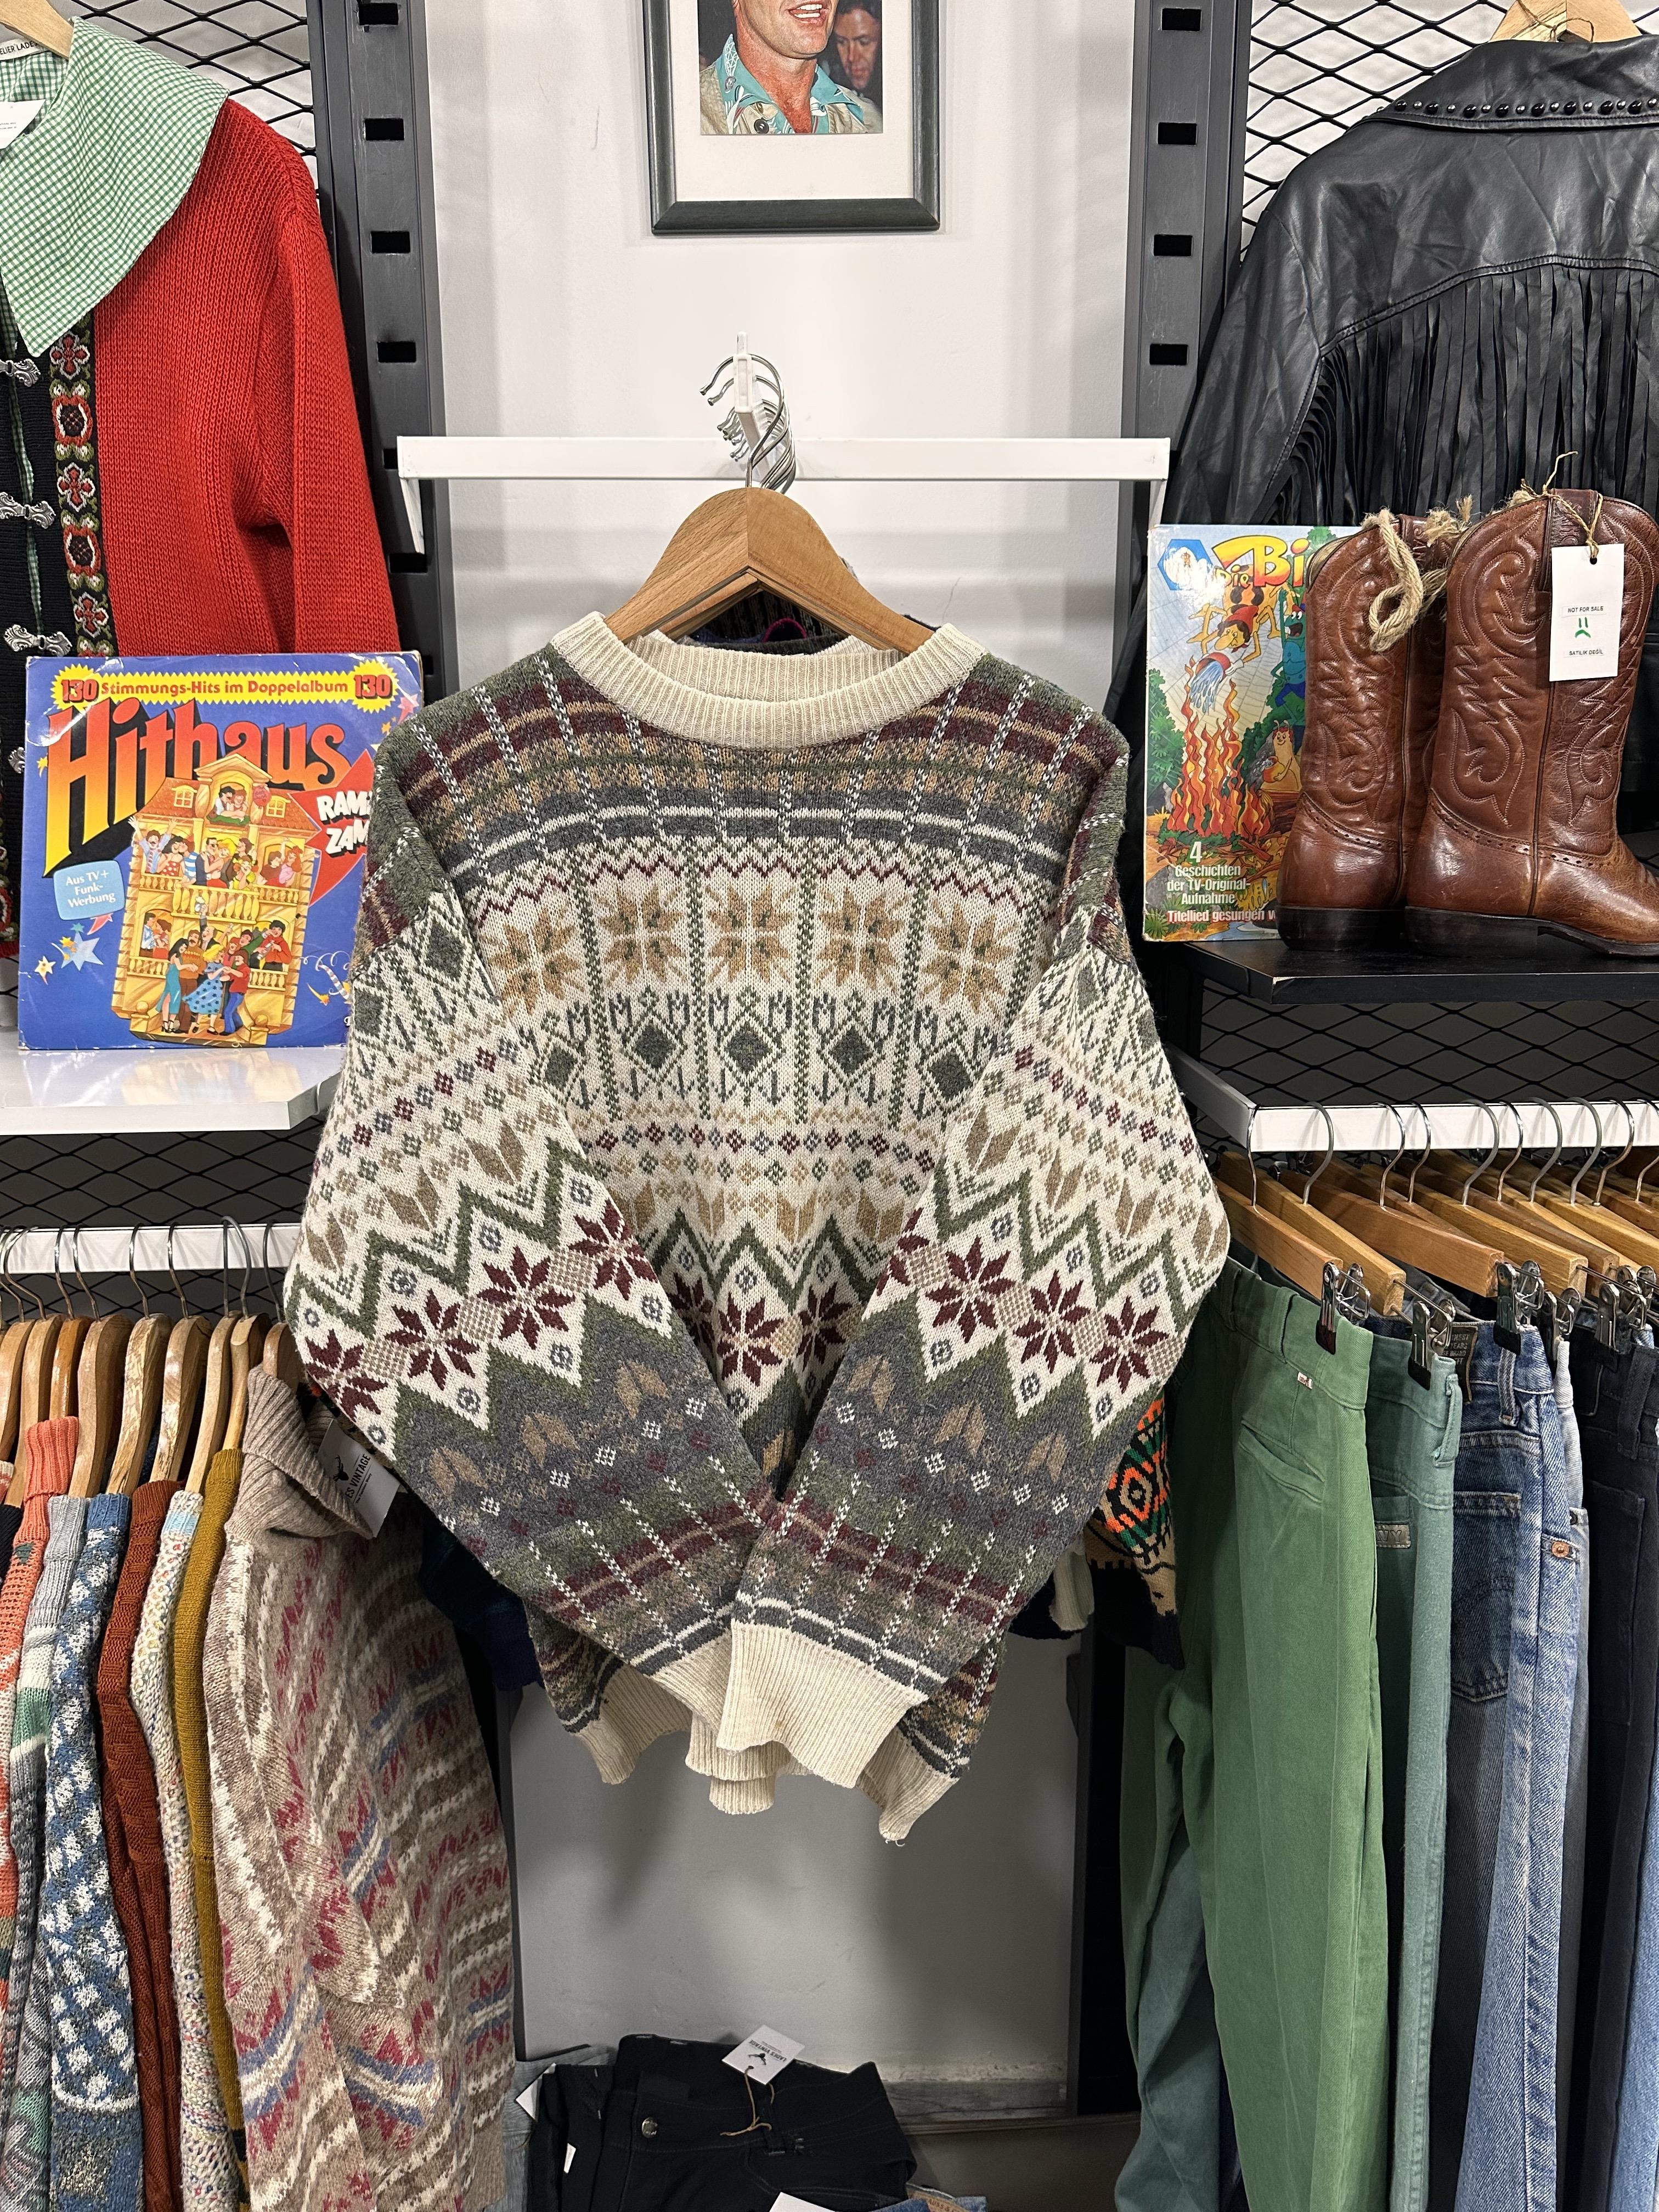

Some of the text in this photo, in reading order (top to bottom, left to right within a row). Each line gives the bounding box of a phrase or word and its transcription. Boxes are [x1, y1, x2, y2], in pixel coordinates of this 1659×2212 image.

[1212, 534, 1315, 588] Bi
[1215, 564, 1251, 589] Die
[61, 674, 393, 703] 130 Stimmungs-Hits im Doppelalbum 130
[43, 697, 353, 877] Hithaus
[317, 790, 373, 823] RAM
[1189, 841, 1203, 863] 4
[1175, 864, 1240, 877] Geschichten
[66, 876, 85, 886] Aus
[75, 882, 104, 895] Funk-
[1167, 878, 1251, 891] der TV-Original-
[67, 893, 116, 908] Werbung
[1181, 892, 1235, 905] Aufnahme
[1167, 910, 1209, 923] Titellied
[1212, 909, 1265, 922] gesungen
[349, 1453, 371, 1487] VINTAGE
